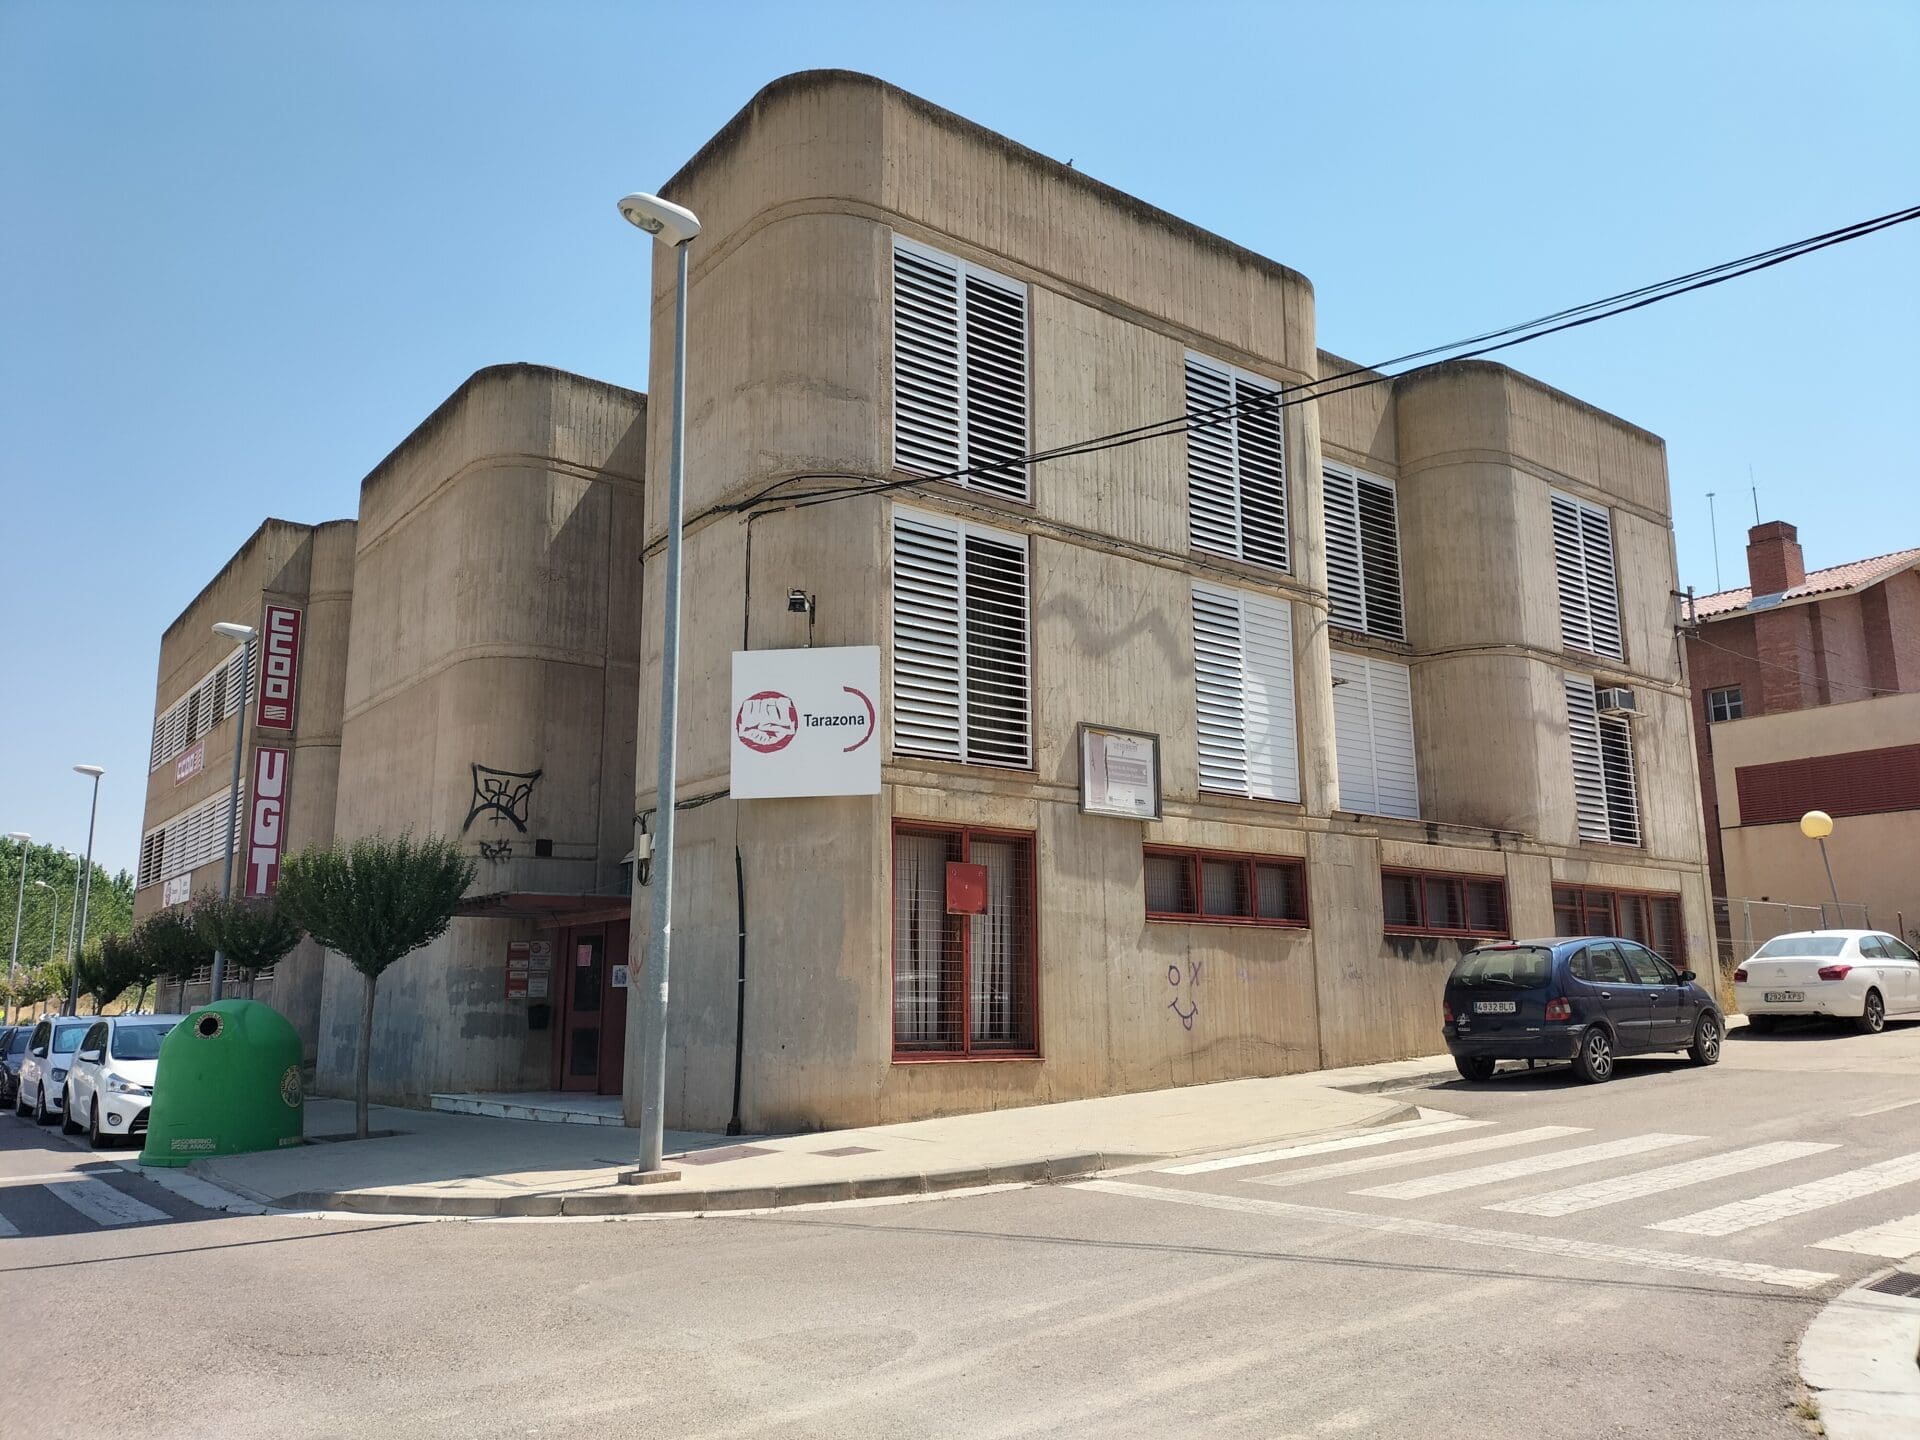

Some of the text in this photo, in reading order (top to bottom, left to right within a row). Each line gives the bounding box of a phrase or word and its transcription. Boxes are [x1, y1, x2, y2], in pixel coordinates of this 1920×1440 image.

[265, 610, 294, 700] CCOO
[804, 713, 865, 727] Tarazona
[250, 751, 285, 894] UGT
[1478, 1003, 1513, 1011] 4932 BLG
